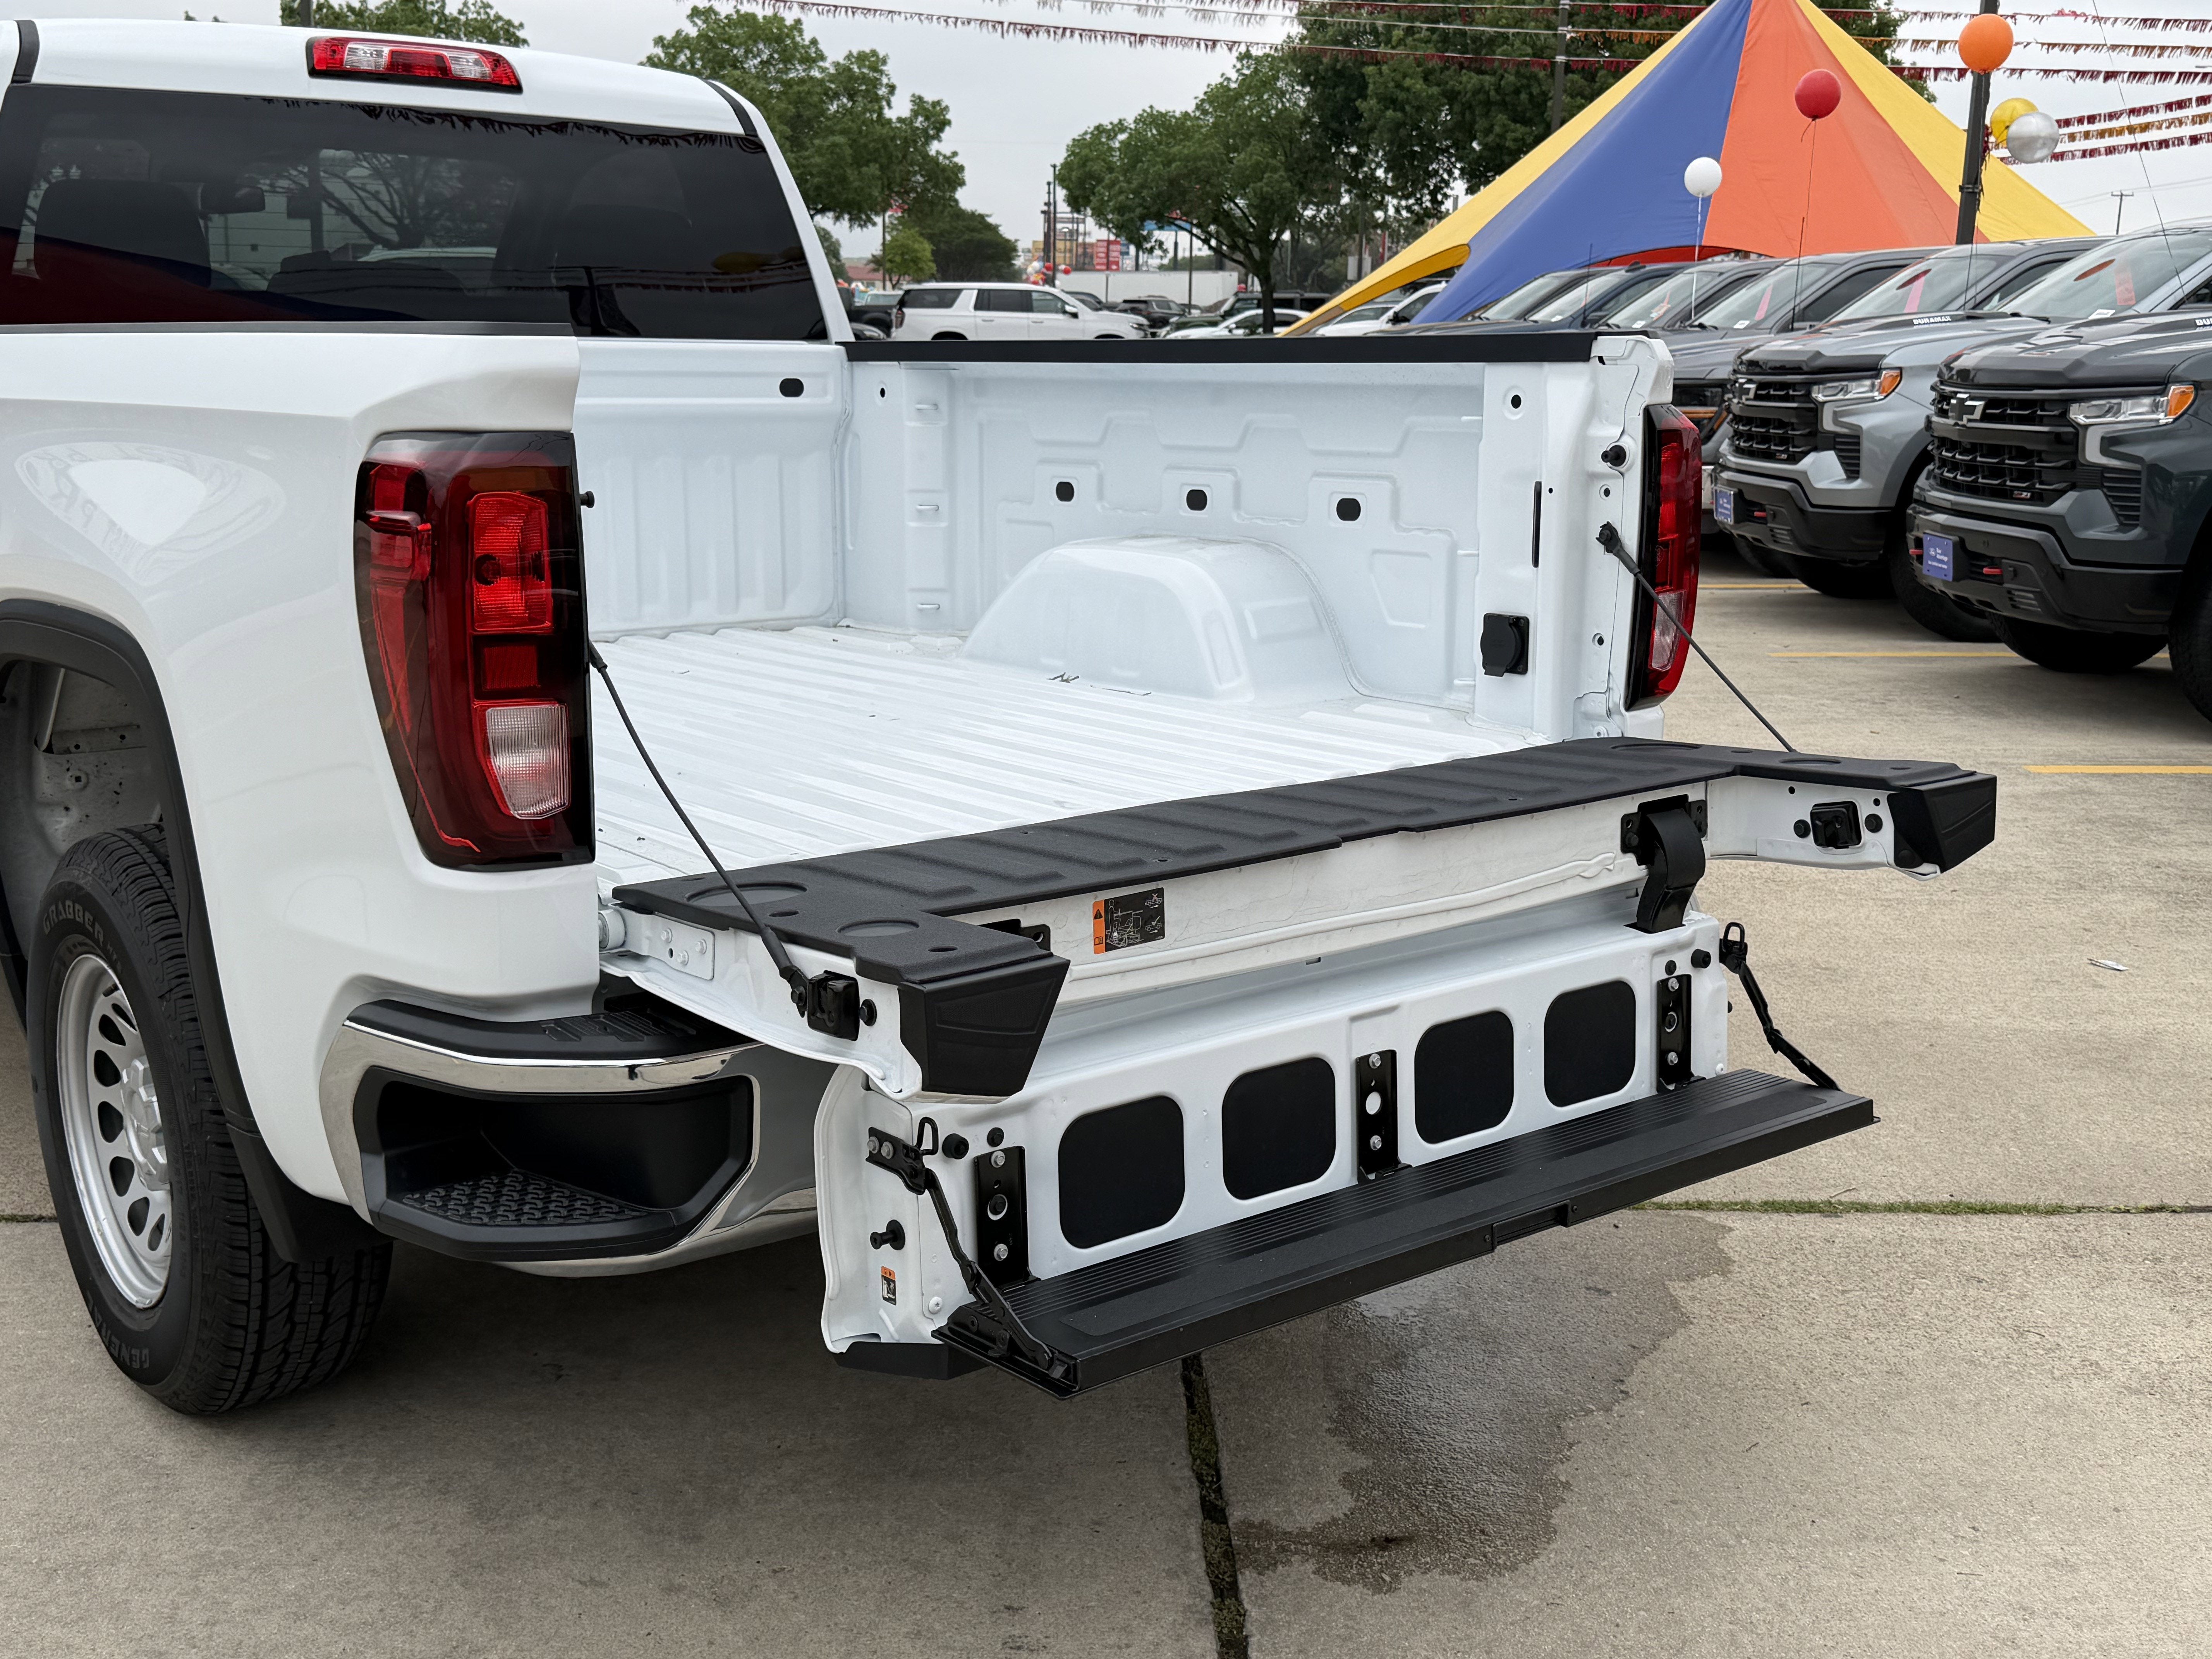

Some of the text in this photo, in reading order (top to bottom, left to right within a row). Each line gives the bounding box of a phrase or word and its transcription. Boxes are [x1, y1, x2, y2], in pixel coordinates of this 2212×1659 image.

[1913, 316, 1951, 325] DURAMAX
[43, 900, 104, 946] GRABBER
[87, 1290, 149, 1369] GENERAL
